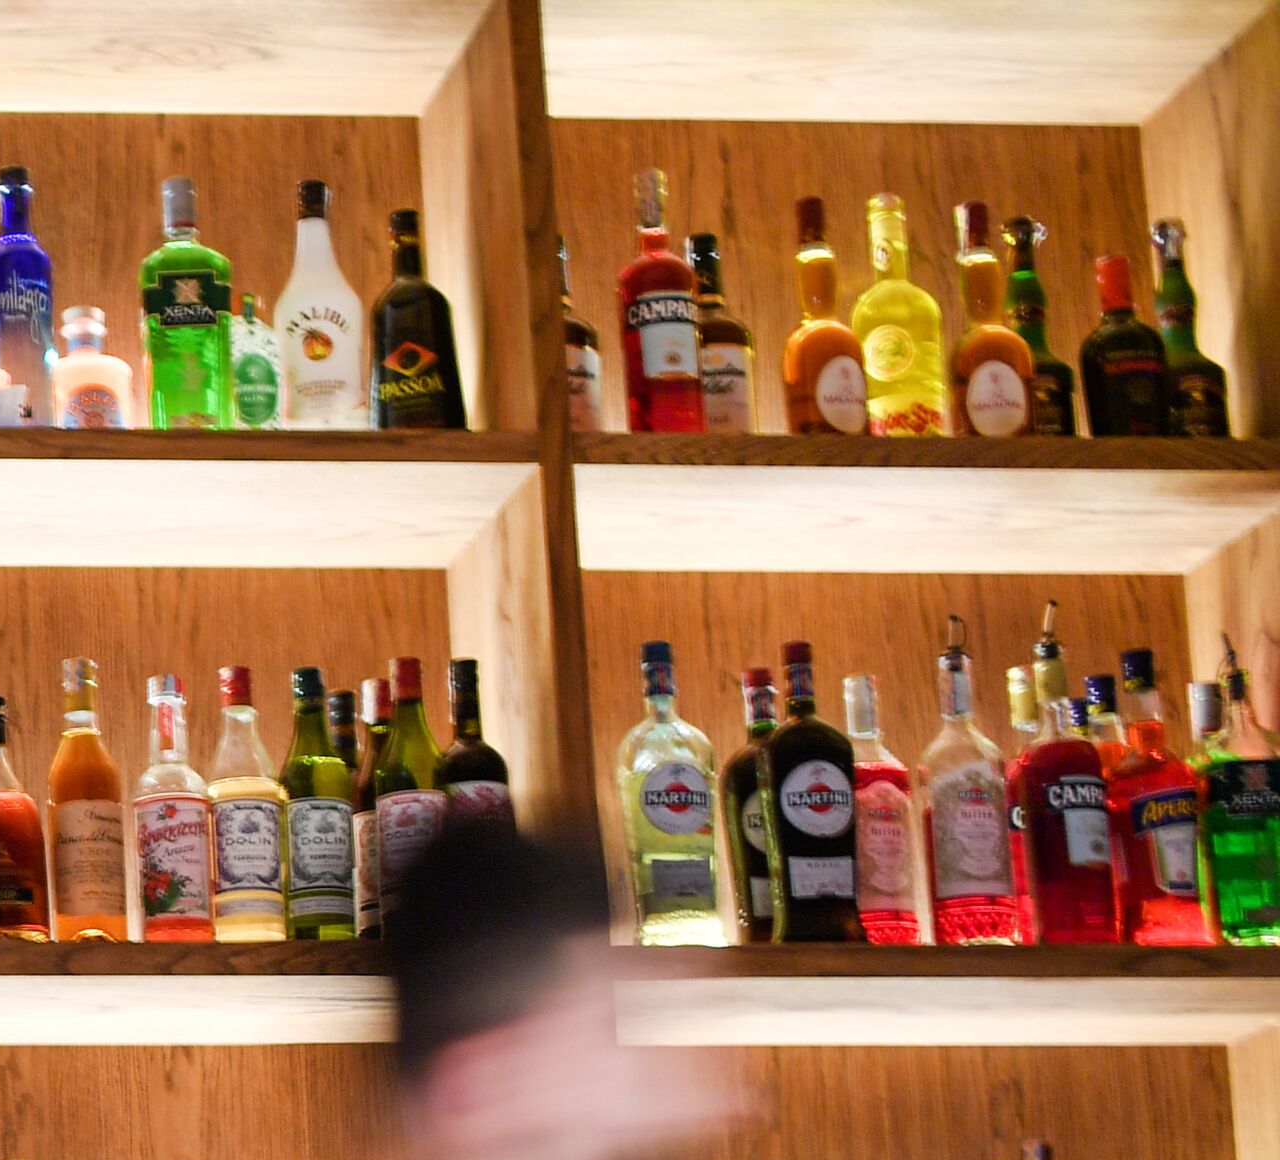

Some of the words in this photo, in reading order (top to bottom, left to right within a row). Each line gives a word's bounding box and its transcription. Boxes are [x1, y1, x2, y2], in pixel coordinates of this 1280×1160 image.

[163, 304, 215, 318] XENTA
[286, 306, 350, 337] MALIBU
[645, 792, 708, 806] MARTINI
[787, 791, 850, 806] MARTINI
[225, 836, 272, 847] DOLIN
[300, 836, 347, 847] DOLIN
